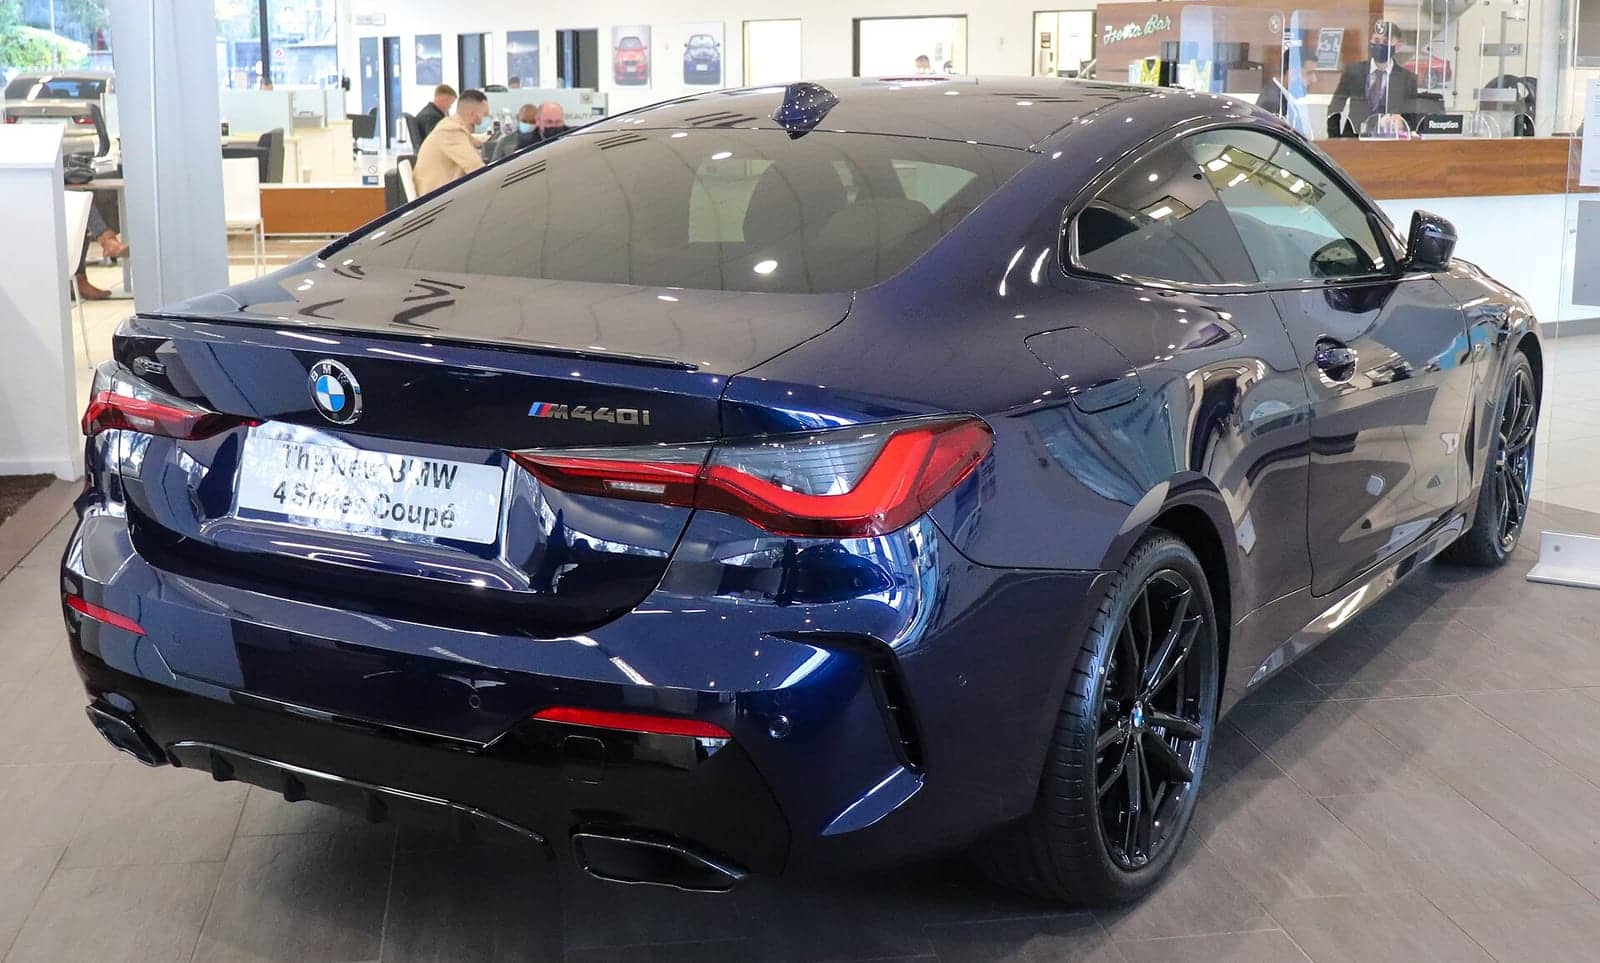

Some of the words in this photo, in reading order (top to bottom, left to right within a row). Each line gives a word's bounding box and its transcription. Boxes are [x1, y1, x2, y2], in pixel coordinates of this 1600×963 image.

[1143, 14, 1171, 35] Bar
[1428, 120, 1459, 131] Reception
[311, 363, 349, 385] BMW
[546, 403, 650, 425] M440i
[281, 443, 324, 473] The
[389, 458, 458, 490] BMW
[273, 480, 287, 505] 4
[373, 492, 456, 532] Coupé
